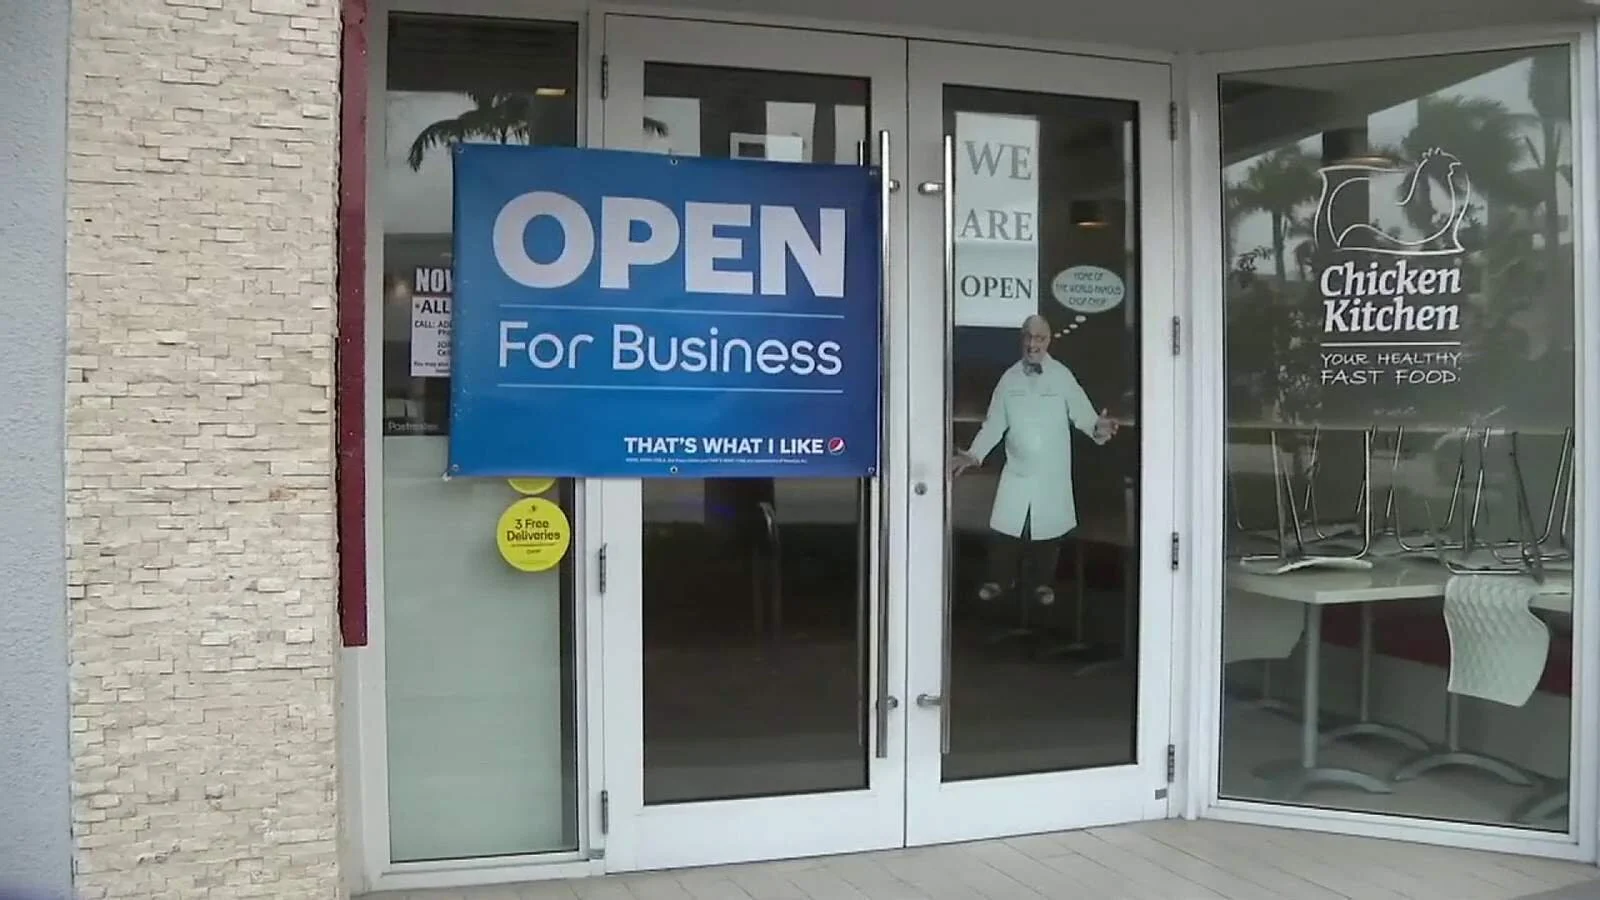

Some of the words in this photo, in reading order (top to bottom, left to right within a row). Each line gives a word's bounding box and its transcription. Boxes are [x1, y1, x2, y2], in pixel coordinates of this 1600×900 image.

[964, 140, 1032, 180] WE
[959, 207, 1033, 241] ARE
[492, 190, 846, 298] OPEN
[960, 274, 1033, 299] OPEN
[1320, 259, 1461, 297] Chicken
[1323, 296, 1460, 333] Kitchen
[499, 320, 594, 369] For
[612, 324, 842, 376] Business
[1320, 353, 1369, 368] YOUR
[1377, 351, 1461, 368] HEALTHY
[1320, 370, 1385, 386] FAST
[624, 436, 698, 454] THAT'S
[702, 437, 763, 454] WHAT
[768, 438, 774, 454] I
[780, 438, 824, 455] LIKE
[506, 529, 561, 542] Deliveries
[514, 518, 523, 530] 3
[525, 518, 550, 529] Free
